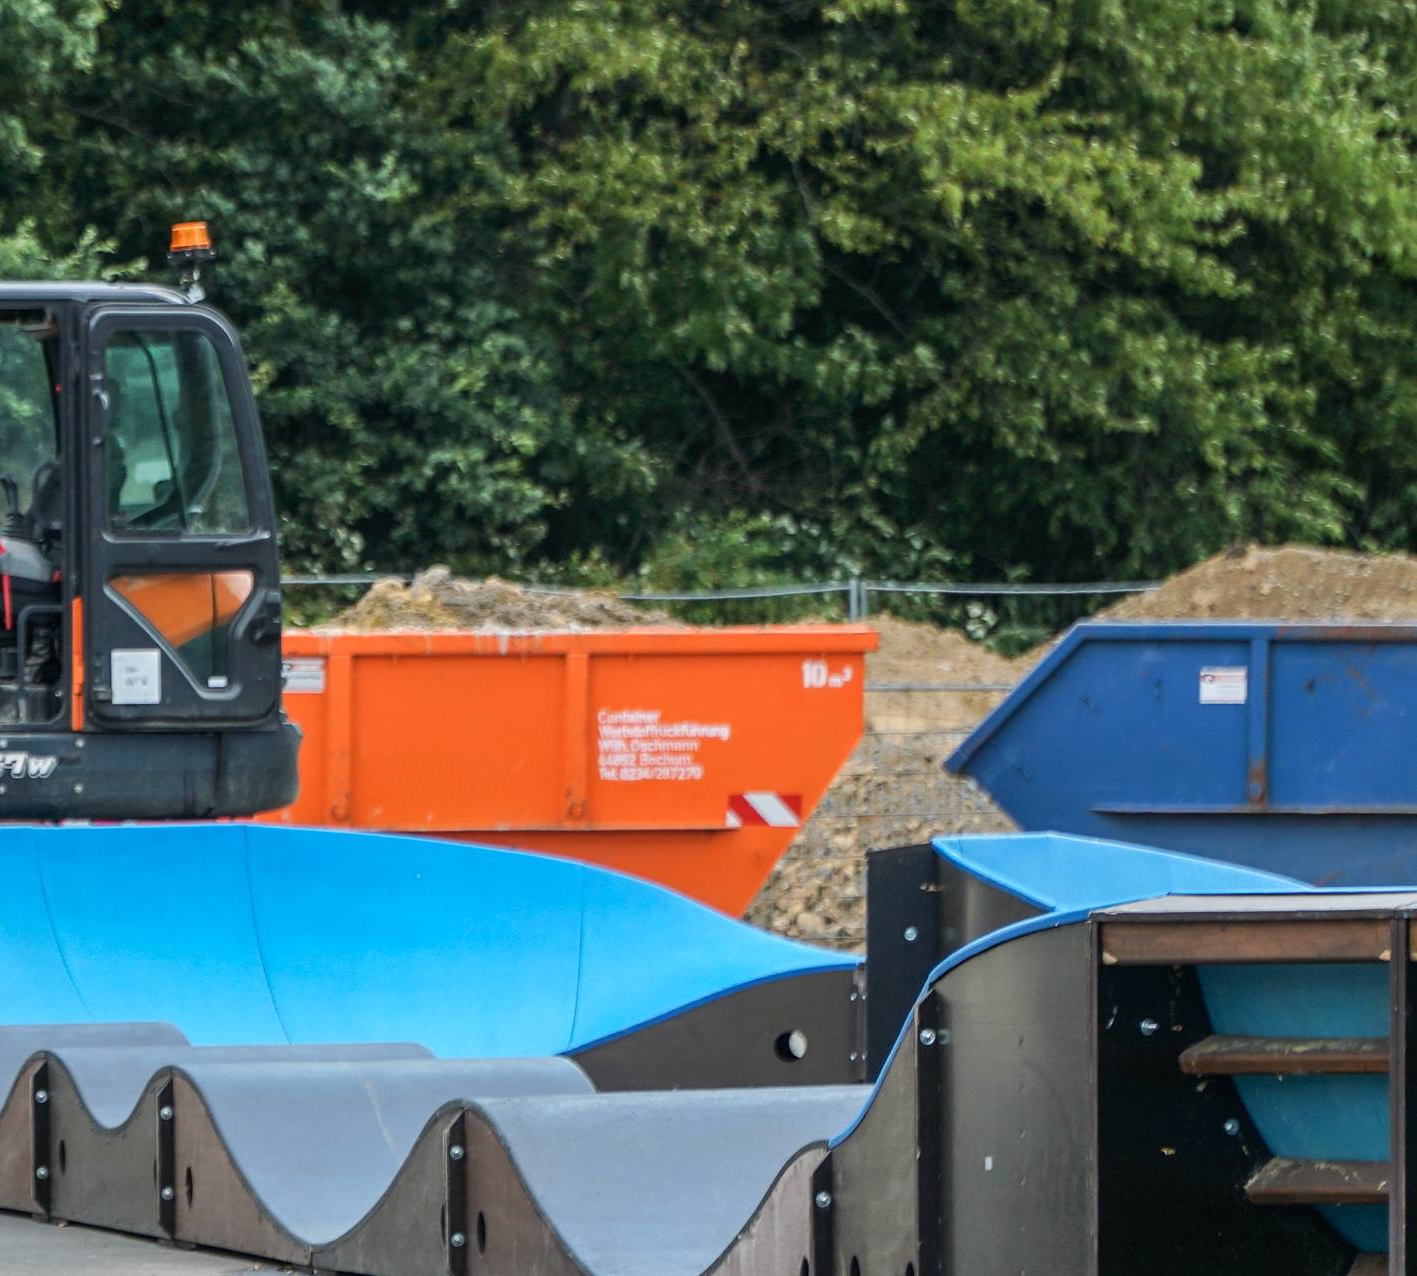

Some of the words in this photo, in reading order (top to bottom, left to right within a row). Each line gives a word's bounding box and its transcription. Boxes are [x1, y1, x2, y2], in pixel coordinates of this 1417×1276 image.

[802, 660, 827, 688] 10
[598, 710, 661, 724] Container
[639, 752, 694, 766] Bochum
